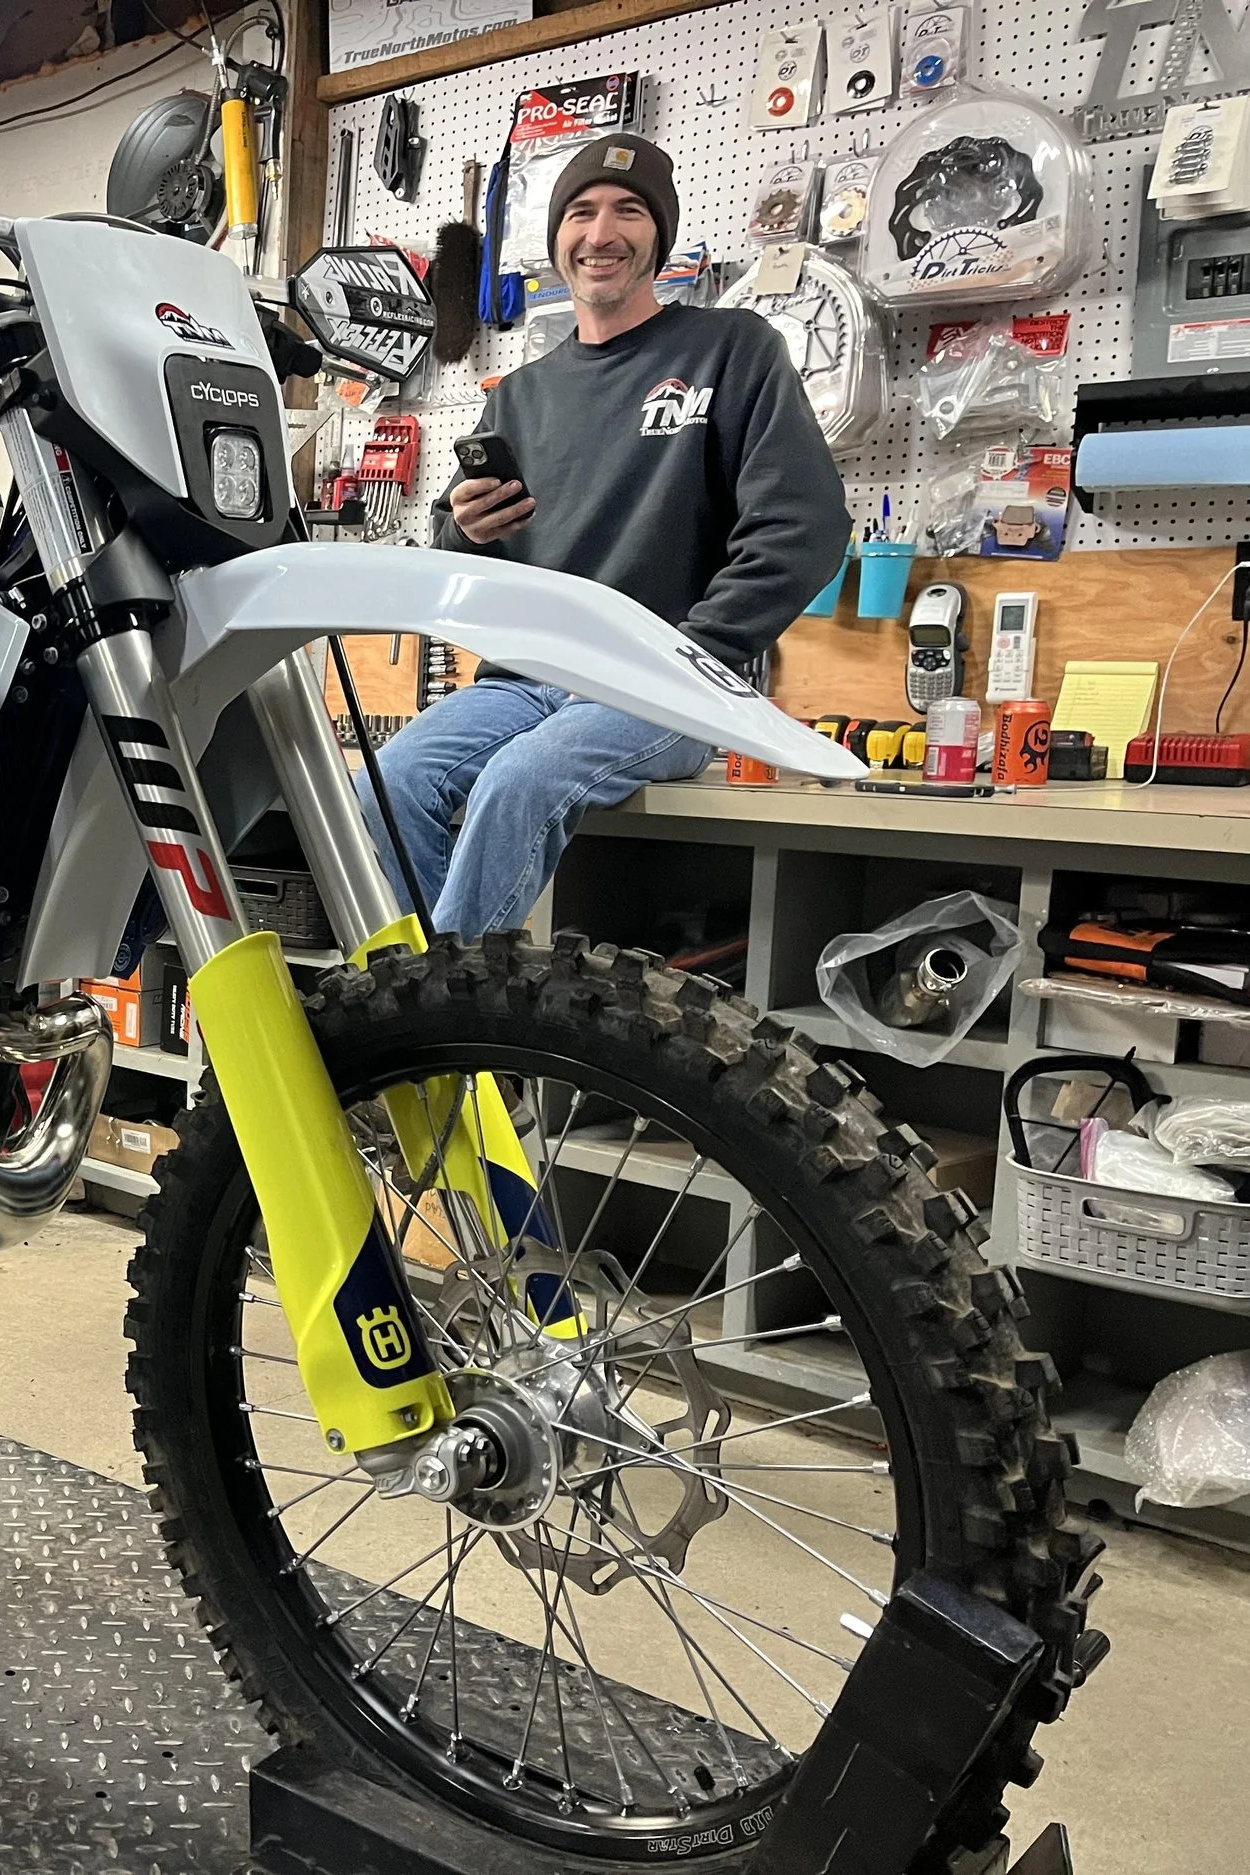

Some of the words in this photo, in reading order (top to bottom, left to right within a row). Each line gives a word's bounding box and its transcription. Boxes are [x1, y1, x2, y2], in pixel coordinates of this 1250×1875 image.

[344, 18, 519, 64] TrueNorthMotos.com
[517, 91, 619, 124] PRO-SEAL
[919, 262, 957, 280] Dirt
[958, 258, 1004, 277] Tricks
[326, 317, 428, 375] REFLEX
[190, 381, 259, 407] CYCLOPS
[641, 386, 714, 427] TNM
[1043, 453, 1070, 465] EBC
[997, 713, 1013, 780] Bodhizafa
